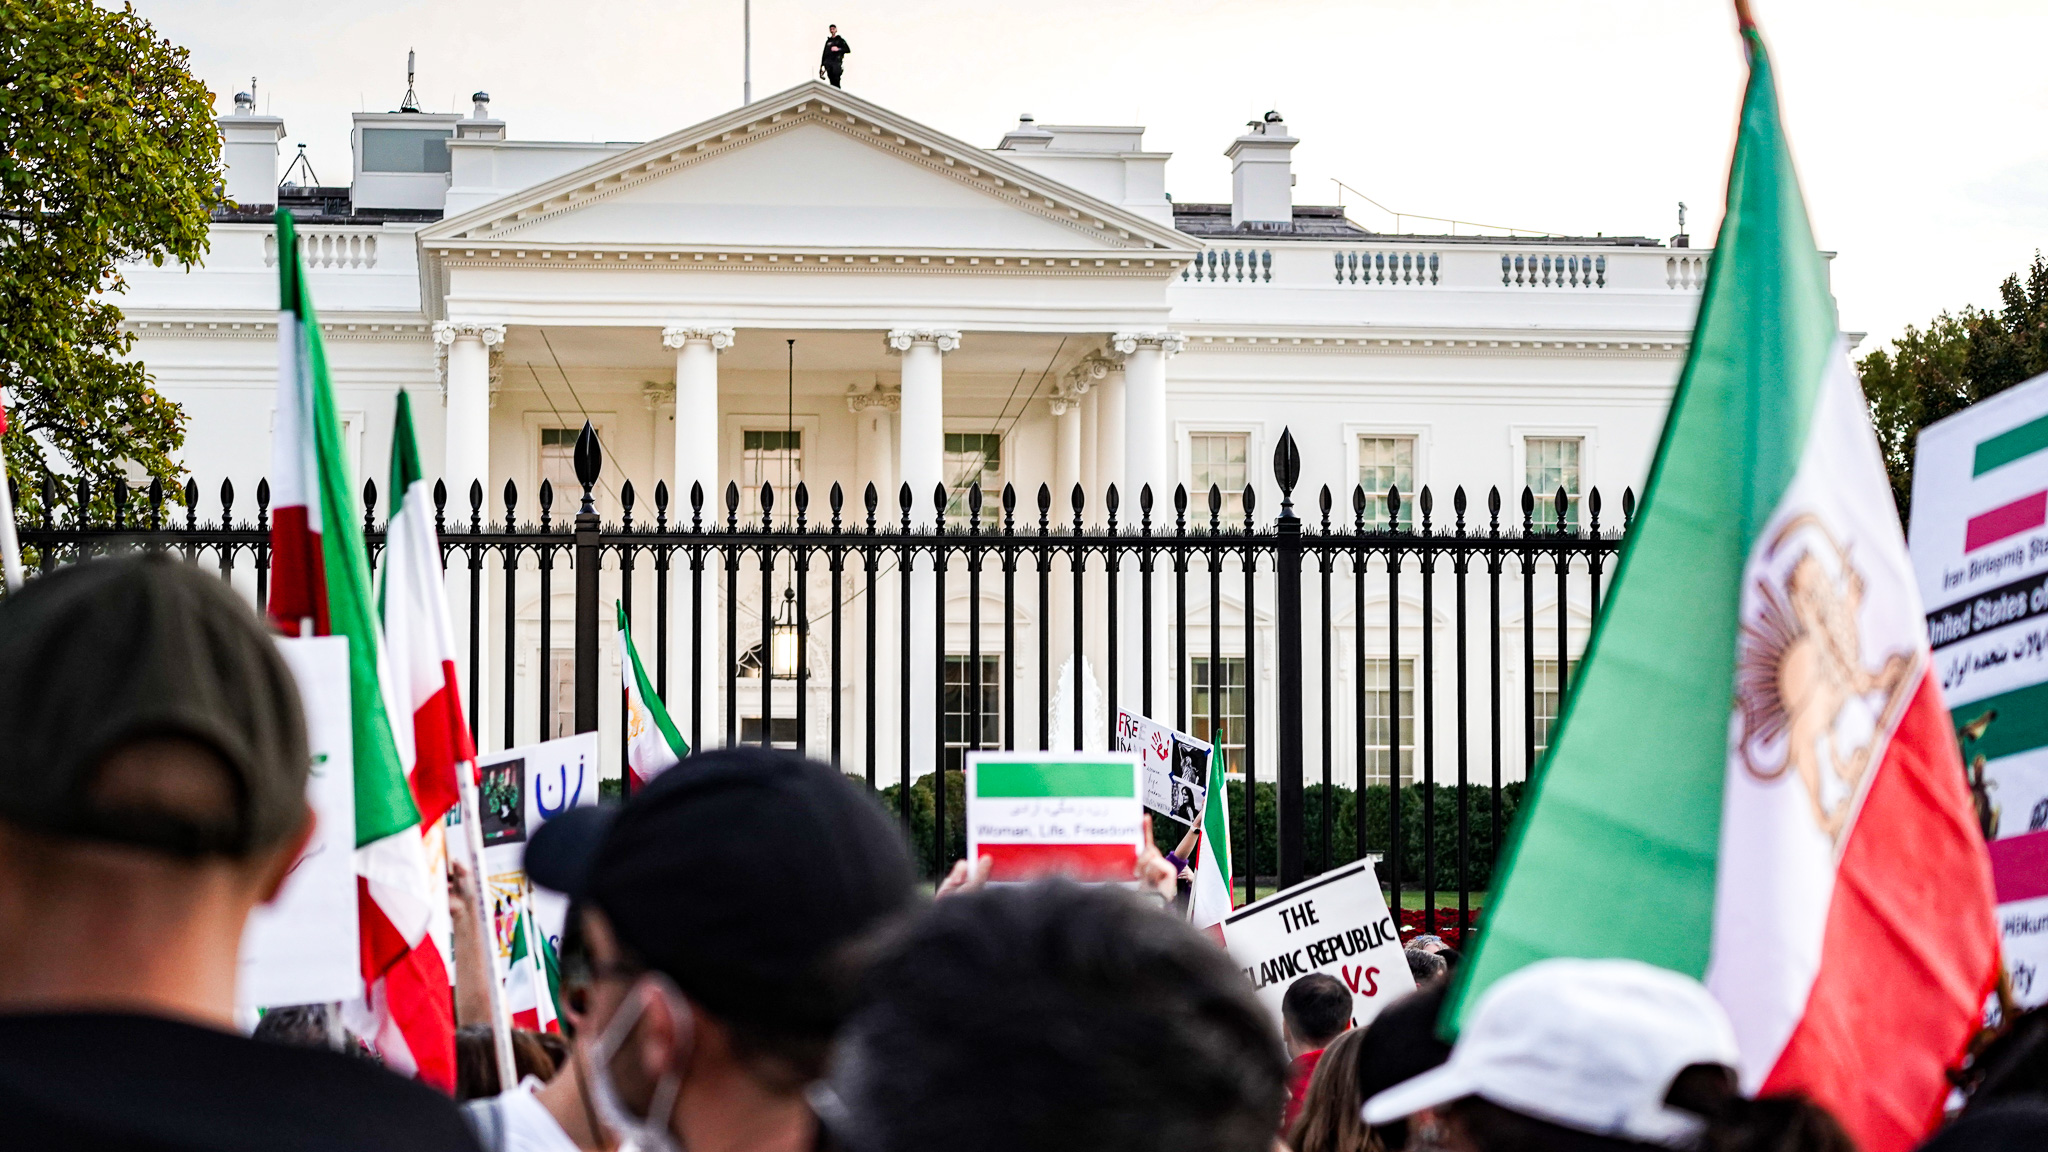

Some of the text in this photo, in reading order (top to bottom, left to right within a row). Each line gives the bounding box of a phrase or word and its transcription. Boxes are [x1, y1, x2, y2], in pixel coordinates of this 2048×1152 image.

[1972, 591, 2027, 637] States
[1118, 711, 1147, 740] FREE
[1279, 900, 1319, 934] THE
[1243, 917, 1395, 992] LAMIC REPUBLIC
[1342, 965, 1380, 997] VS
